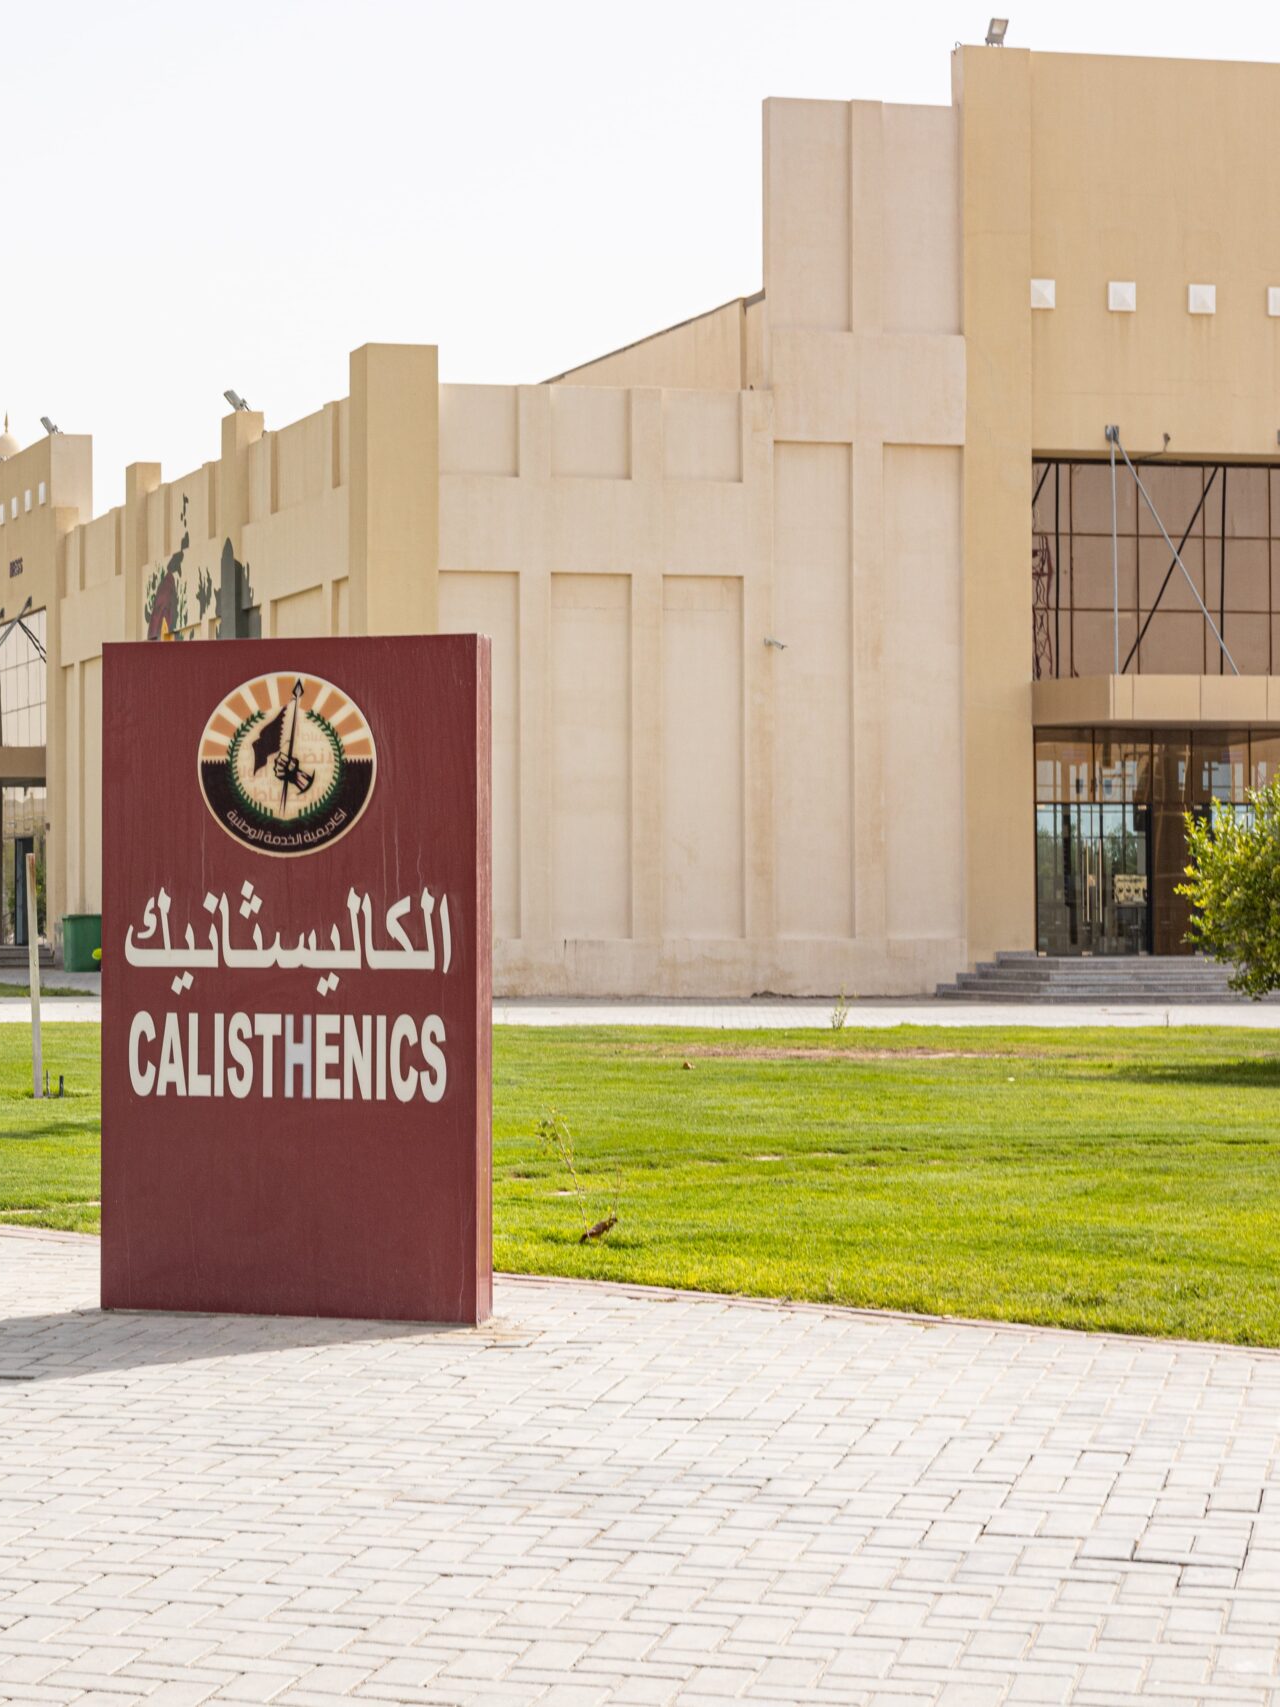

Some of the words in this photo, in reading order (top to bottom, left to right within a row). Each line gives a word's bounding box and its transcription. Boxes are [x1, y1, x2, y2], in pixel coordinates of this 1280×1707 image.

[226, 809, 264, 841] الوطنية
[263, 830, 302, 846] الخدمة
[125, 880, 451, 996] الكاليسثانيك
[128, 1010, 447, 1103] CALISTHENICS
